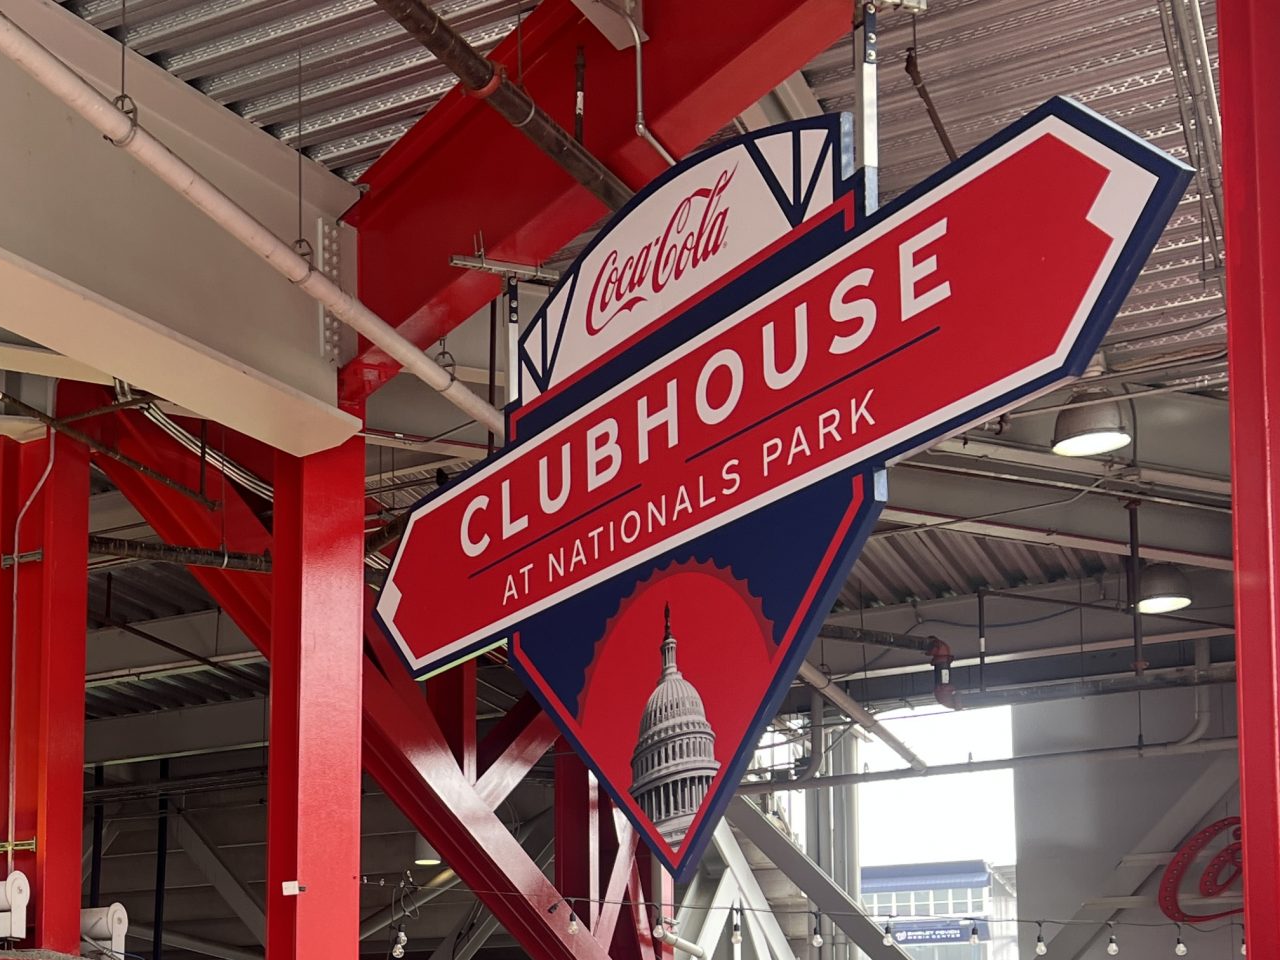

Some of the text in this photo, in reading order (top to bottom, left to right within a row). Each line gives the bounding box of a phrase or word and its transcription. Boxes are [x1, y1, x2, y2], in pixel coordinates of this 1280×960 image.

[586, 161, 739, 336] Coca-Cola
[460, 217, 952, 557] CLUBHOUSE
[502, 389, 877, 605] AT NATIONALS PARK
